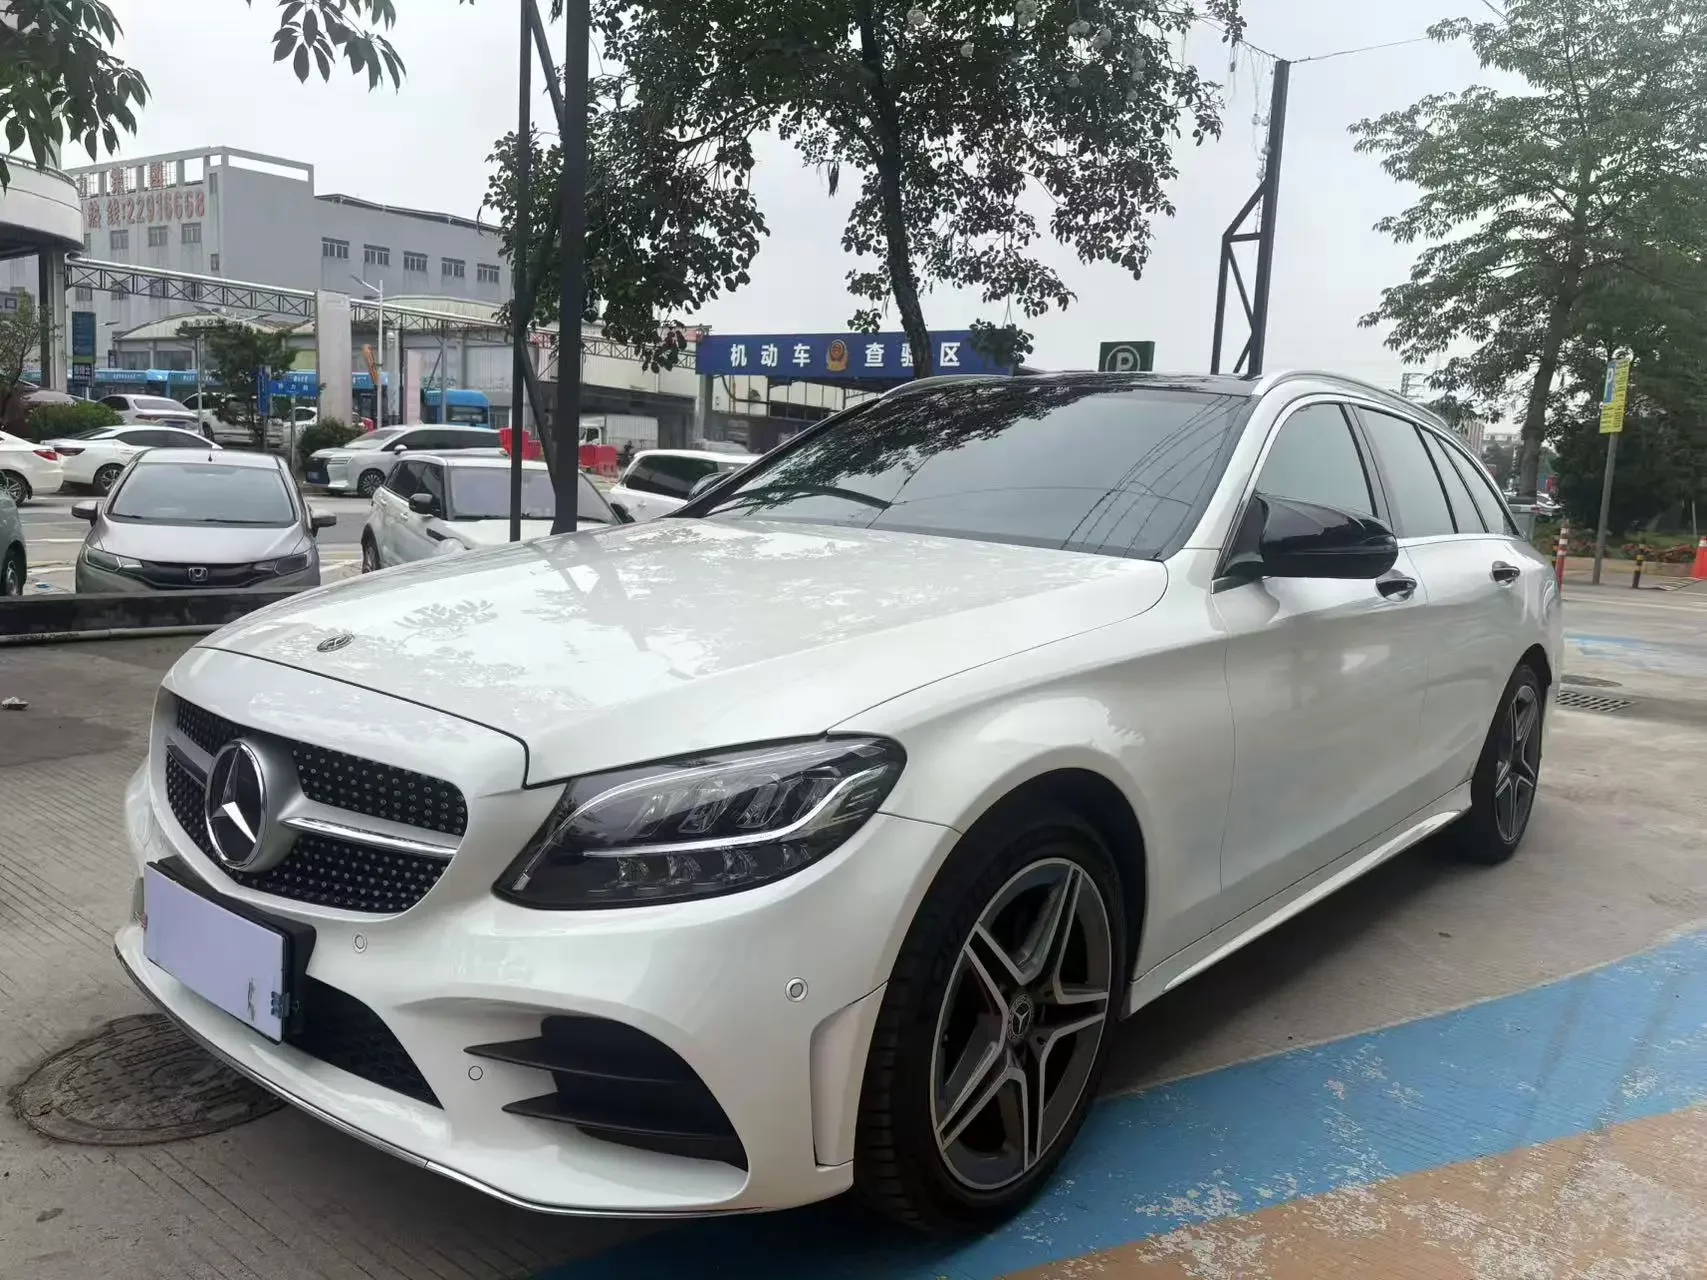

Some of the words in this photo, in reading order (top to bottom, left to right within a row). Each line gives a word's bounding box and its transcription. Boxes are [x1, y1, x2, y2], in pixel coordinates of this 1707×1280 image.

[730, 342, 811, 367] 机动车
[1116, 351, 1134, 371] P
